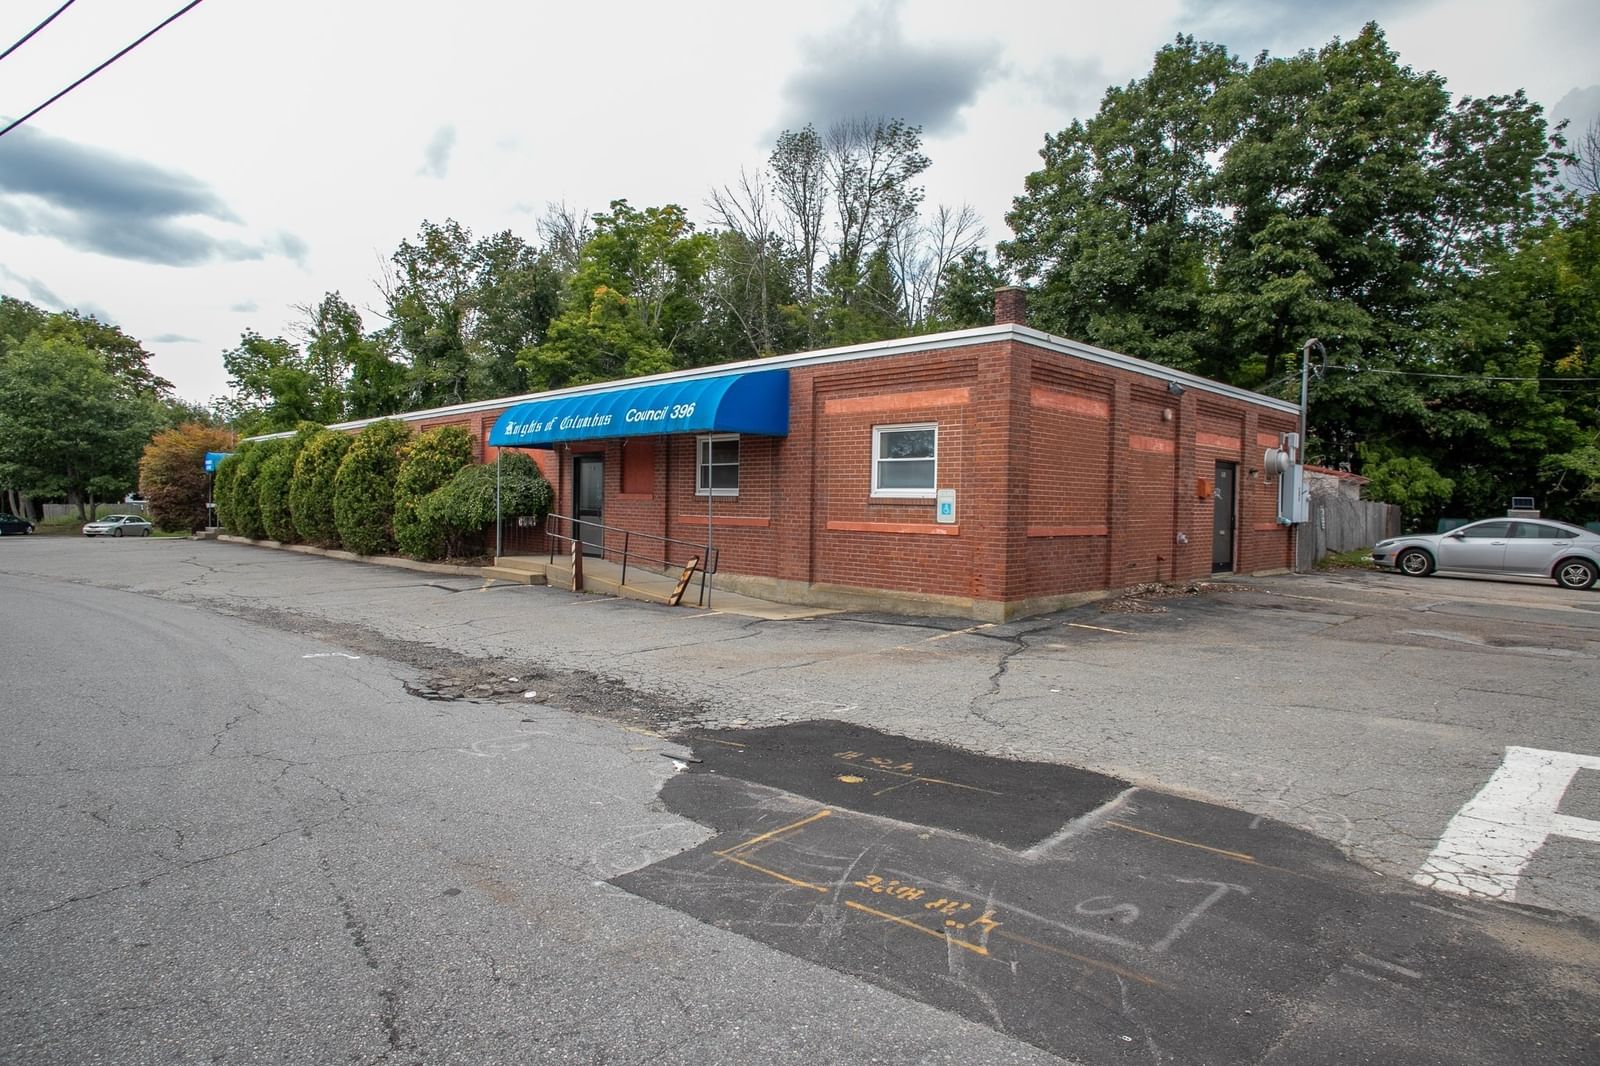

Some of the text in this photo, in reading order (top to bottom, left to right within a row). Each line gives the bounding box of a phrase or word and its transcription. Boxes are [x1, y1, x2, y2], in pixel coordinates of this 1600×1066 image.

[504, 402, 697, 437] Knights of Columbus Council 396
